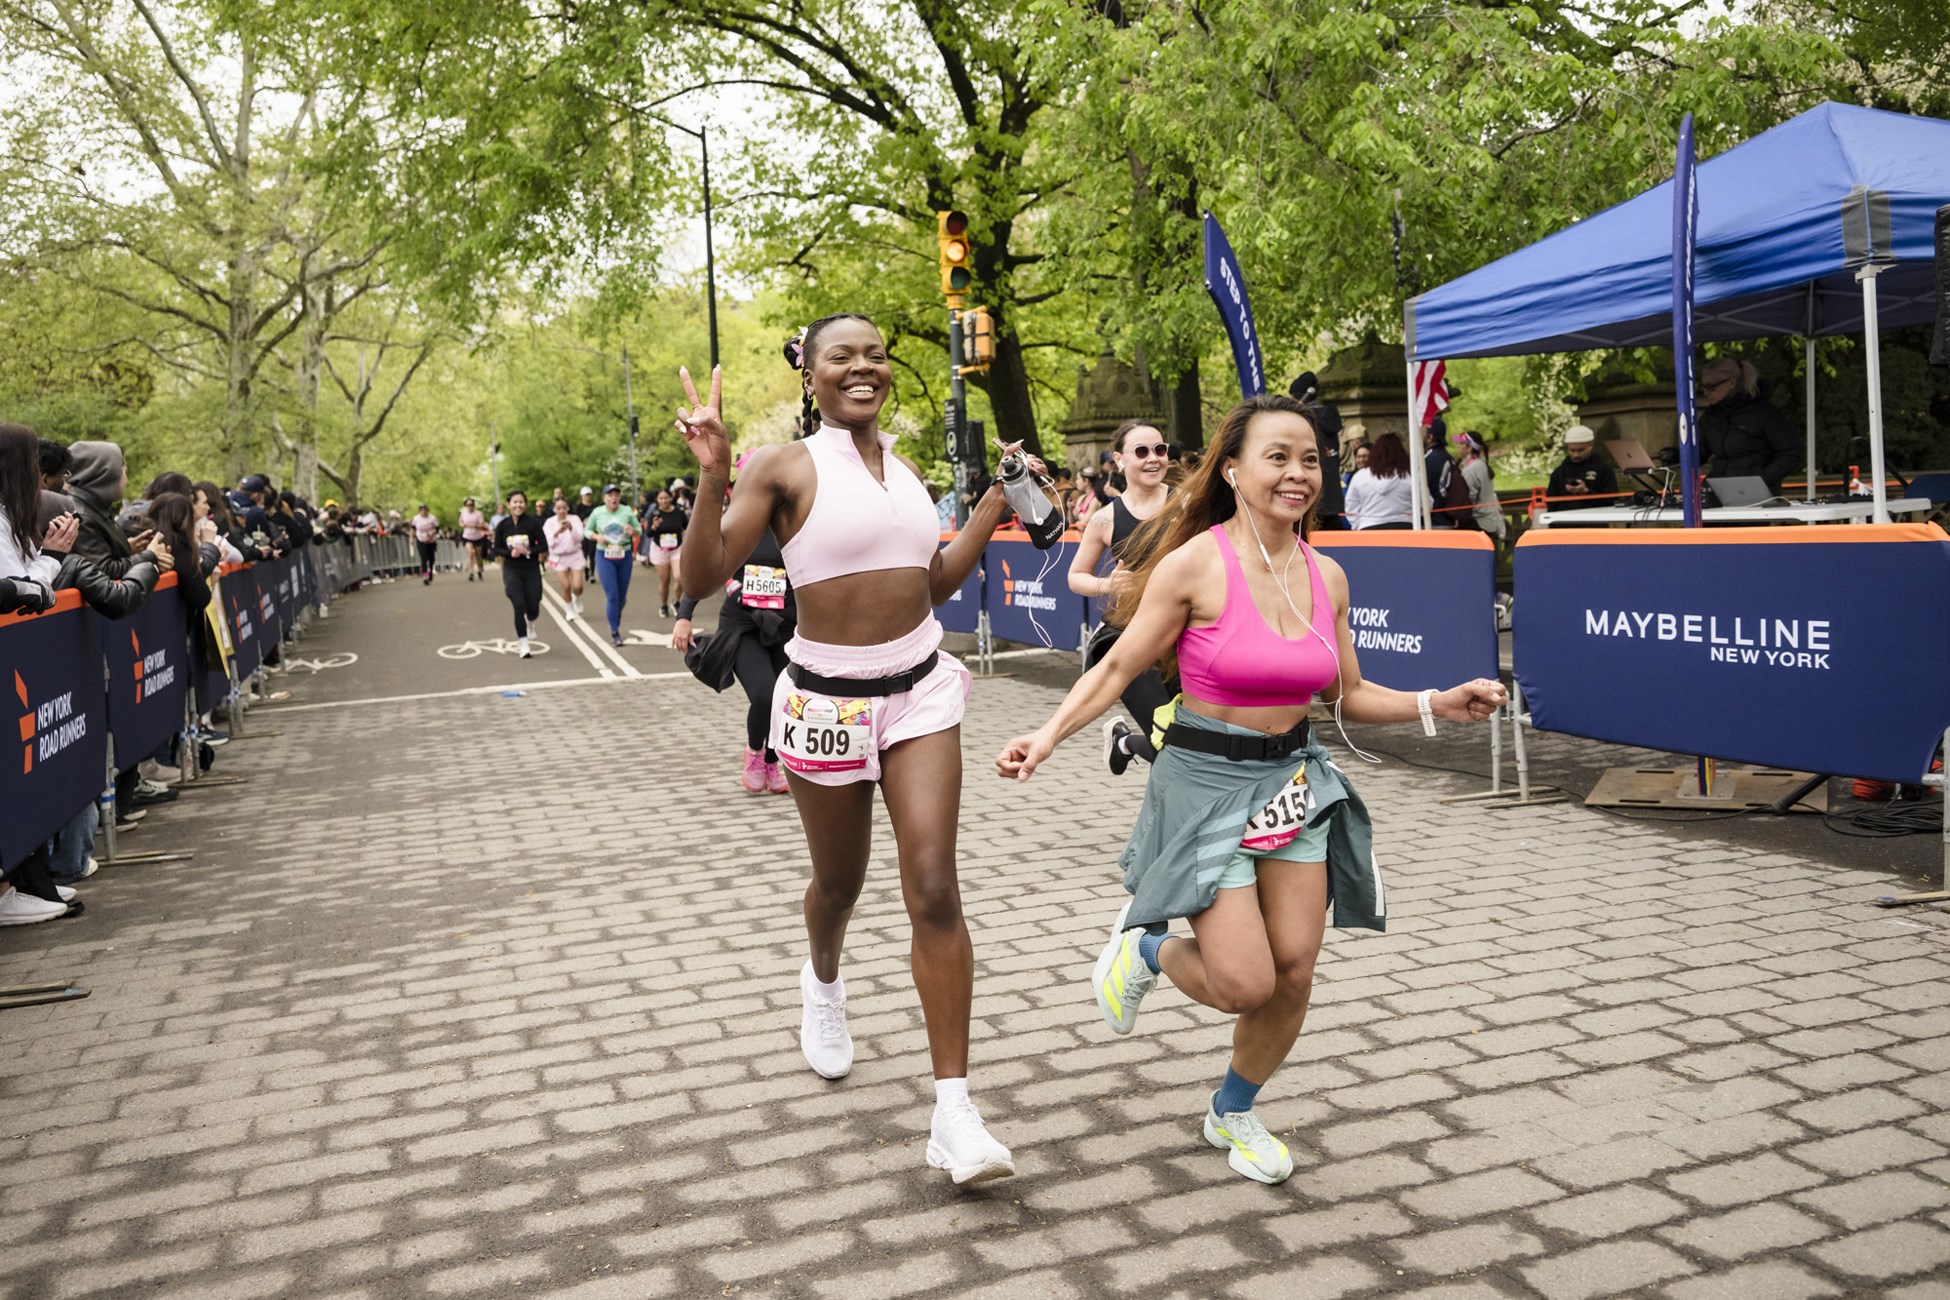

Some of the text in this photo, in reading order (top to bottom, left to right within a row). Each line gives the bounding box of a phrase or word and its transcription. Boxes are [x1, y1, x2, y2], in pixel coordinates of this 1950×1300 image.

[1220, 256, 1261, 392] STEP TO THE
[1045, 521, 1064, 540] NATHAN
[1352, 606, 1390, 628] YORK
[1585, 609, 1830, 650] MAYBELLINE
[1357, 630, 1423, 654] RUNNERS
[1710, 646, 1831, 670] NEW YORK
[144, 648, 166, 675] NEW YORK
[144, 664, 174, 698] ROAD RUNNERS
[38, 690, 72, 732] NEW YORK
[40, 712, 86, 762] ROAD RUNNERS
[783, 722, 850, 756] K 509
[1263, 790, 1308, 828] 515
